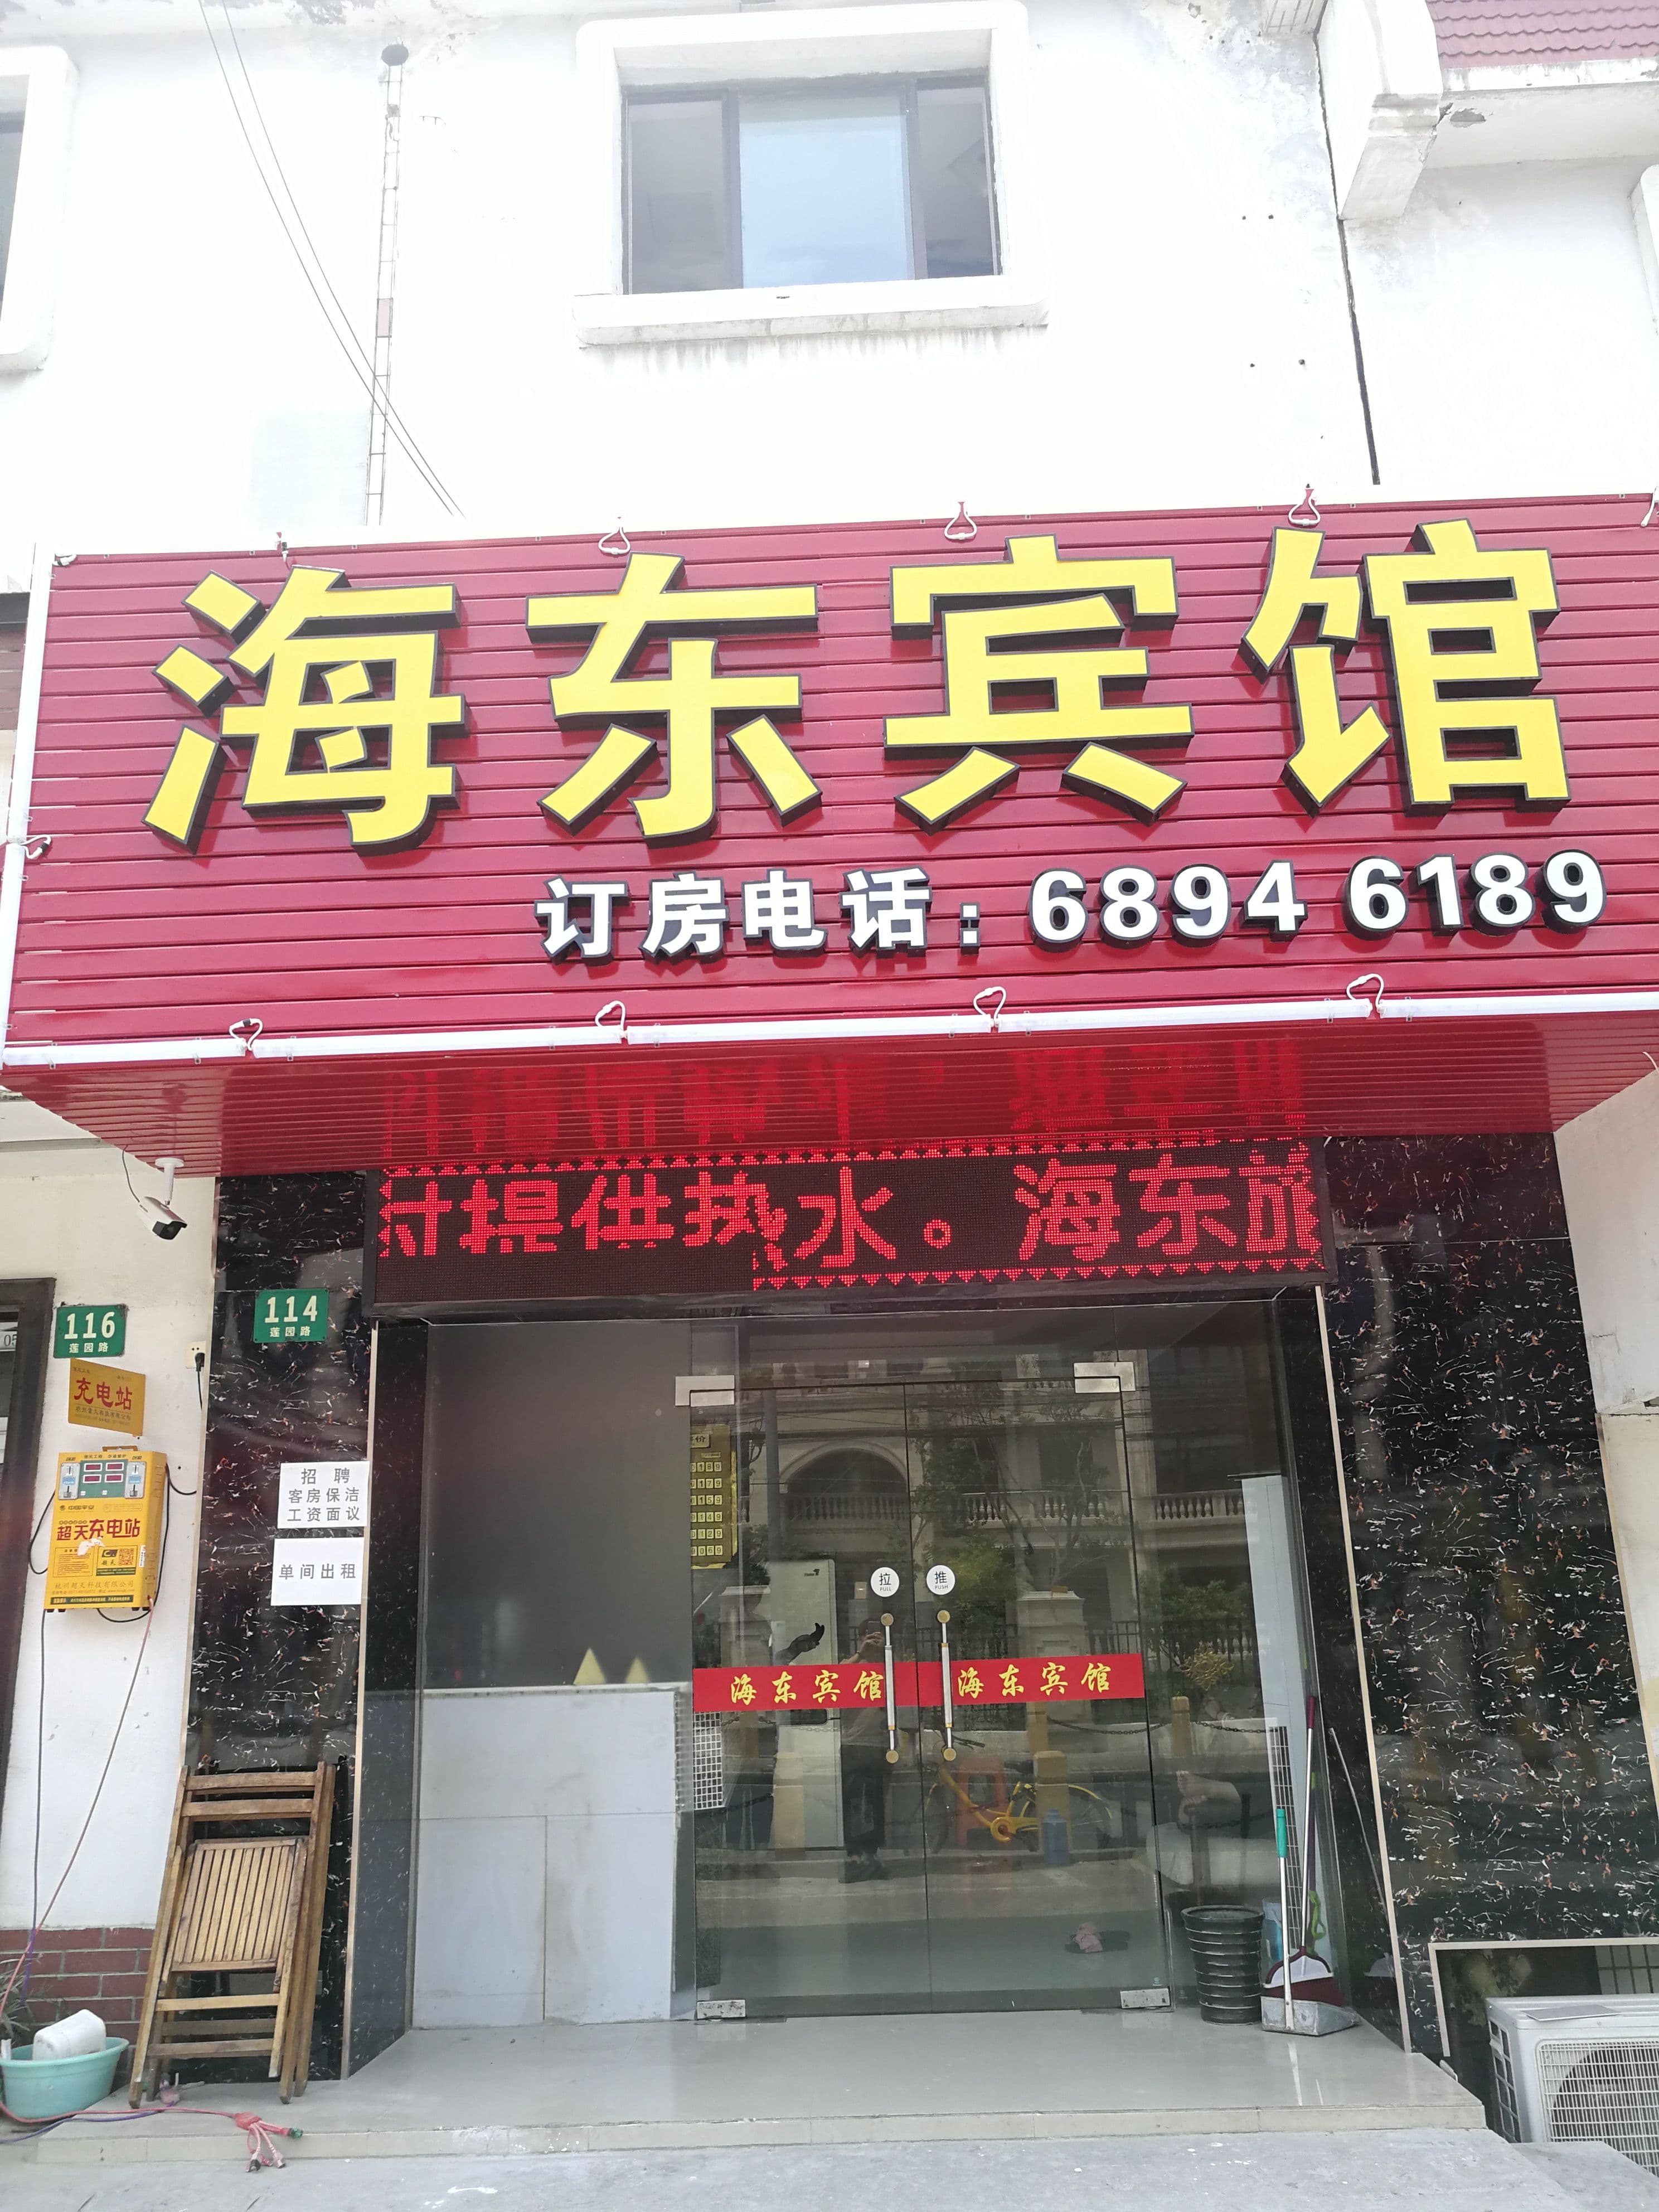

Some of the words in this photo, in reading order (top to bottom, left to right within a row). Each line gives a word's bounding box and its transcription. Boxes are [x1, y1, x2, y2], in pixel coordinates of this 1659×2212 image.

[142, 518, 1570, 853] 海东宾馆
[265, 1295, 318, 1323] 114
[64, 1311, 115, 1340] 116
[270, 1326, 311, 1337] 莲园路
[69, 1342, 108, 1354] 莲园路
[74, 1377, 133, 1410] 充电站
[301, 1468, 350, 1485] 招聘
[288, 1487, 360, 1504] 客房保洁
[287, 1506, 360, 1522] 工资面议
[56, 1518, 140, 1541] 超天充电站
[278, 1563, 356, 1580] 单间出租
[879, 1573, 891, 1586] 拉
[934, 1571, 948, 1584] 推
[730, 1669, 885, 1706] 海东宾馆
[957, 1662, 1113, 1699] 海东宾馆
